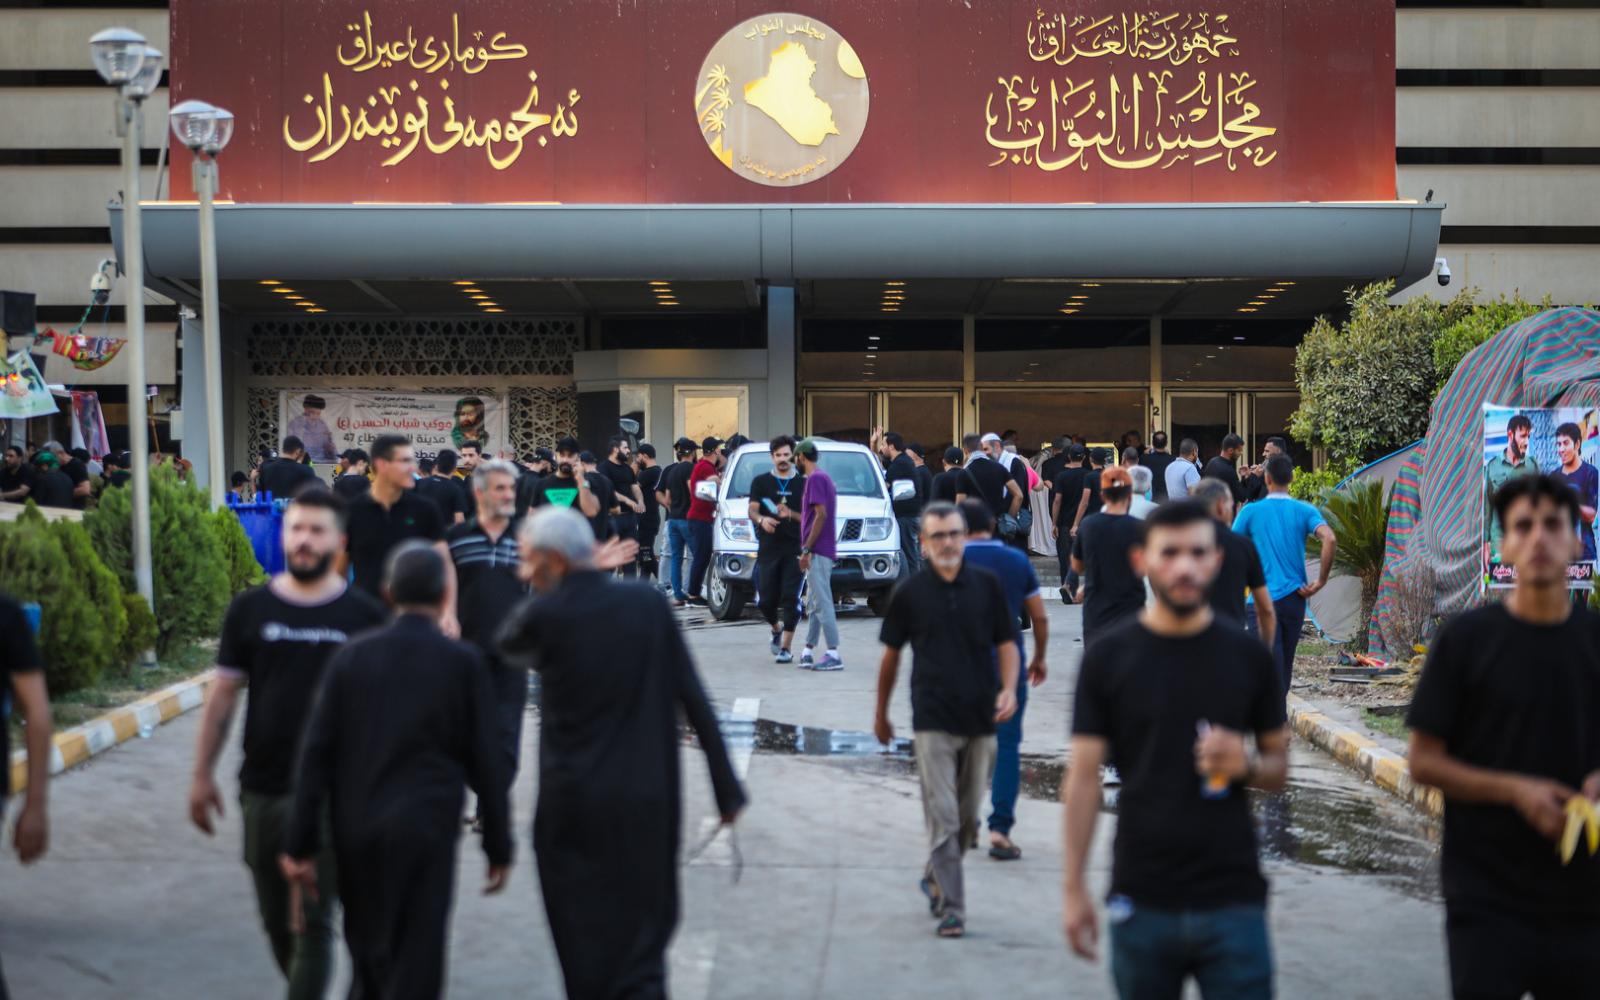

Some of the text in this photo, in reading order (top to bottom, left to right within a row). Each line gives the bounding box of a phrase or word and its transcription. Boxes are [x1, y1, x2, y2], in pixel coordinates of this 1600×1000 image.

[743, 17, 827, 41] مجلس النواب
[1152, 406, 1160, 416] 2
[353, 417, 390, 429] الحسين
[357, 432, 376, 445] طاع
[416, 433, 446, 444] مدينة
